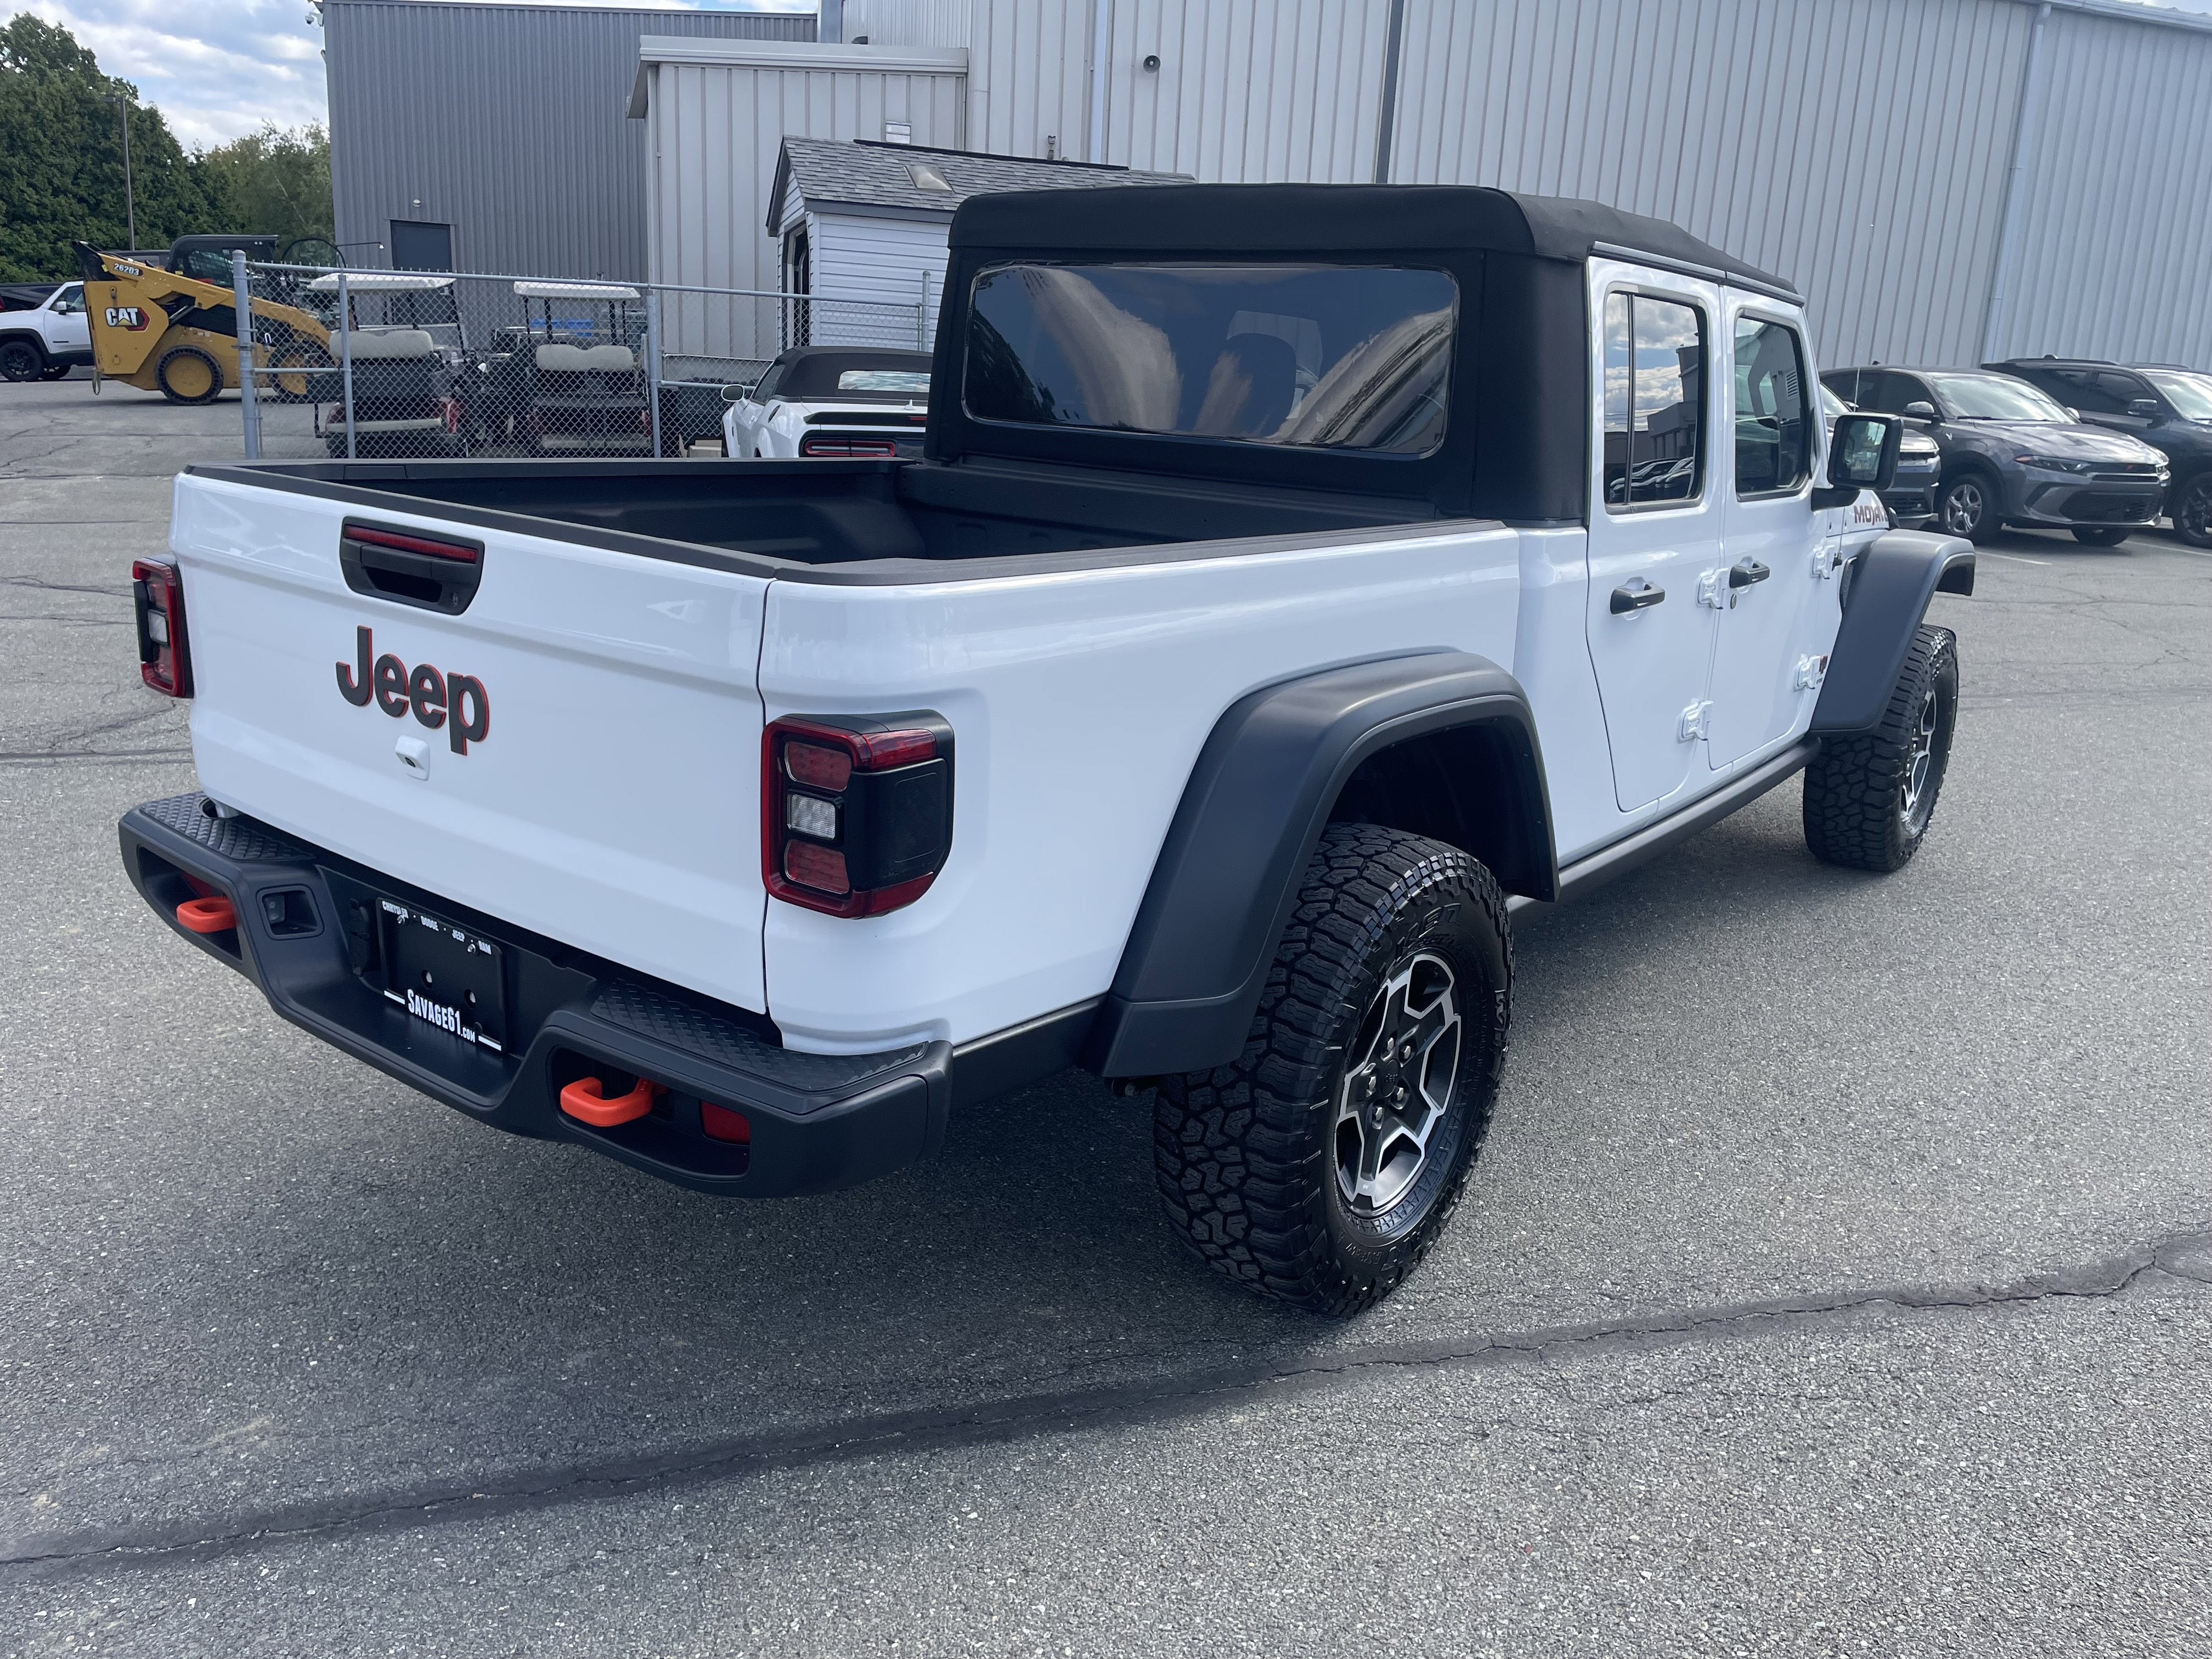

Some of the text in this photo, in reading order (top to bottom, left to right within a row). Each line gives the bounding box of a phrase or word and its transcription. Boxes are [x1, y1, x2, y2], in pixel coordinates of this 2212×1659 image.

[114, 263, 139, 275] 262D3
[105, 307, 138, 326] CAT
[335, 624, 490, 756] Jeep
